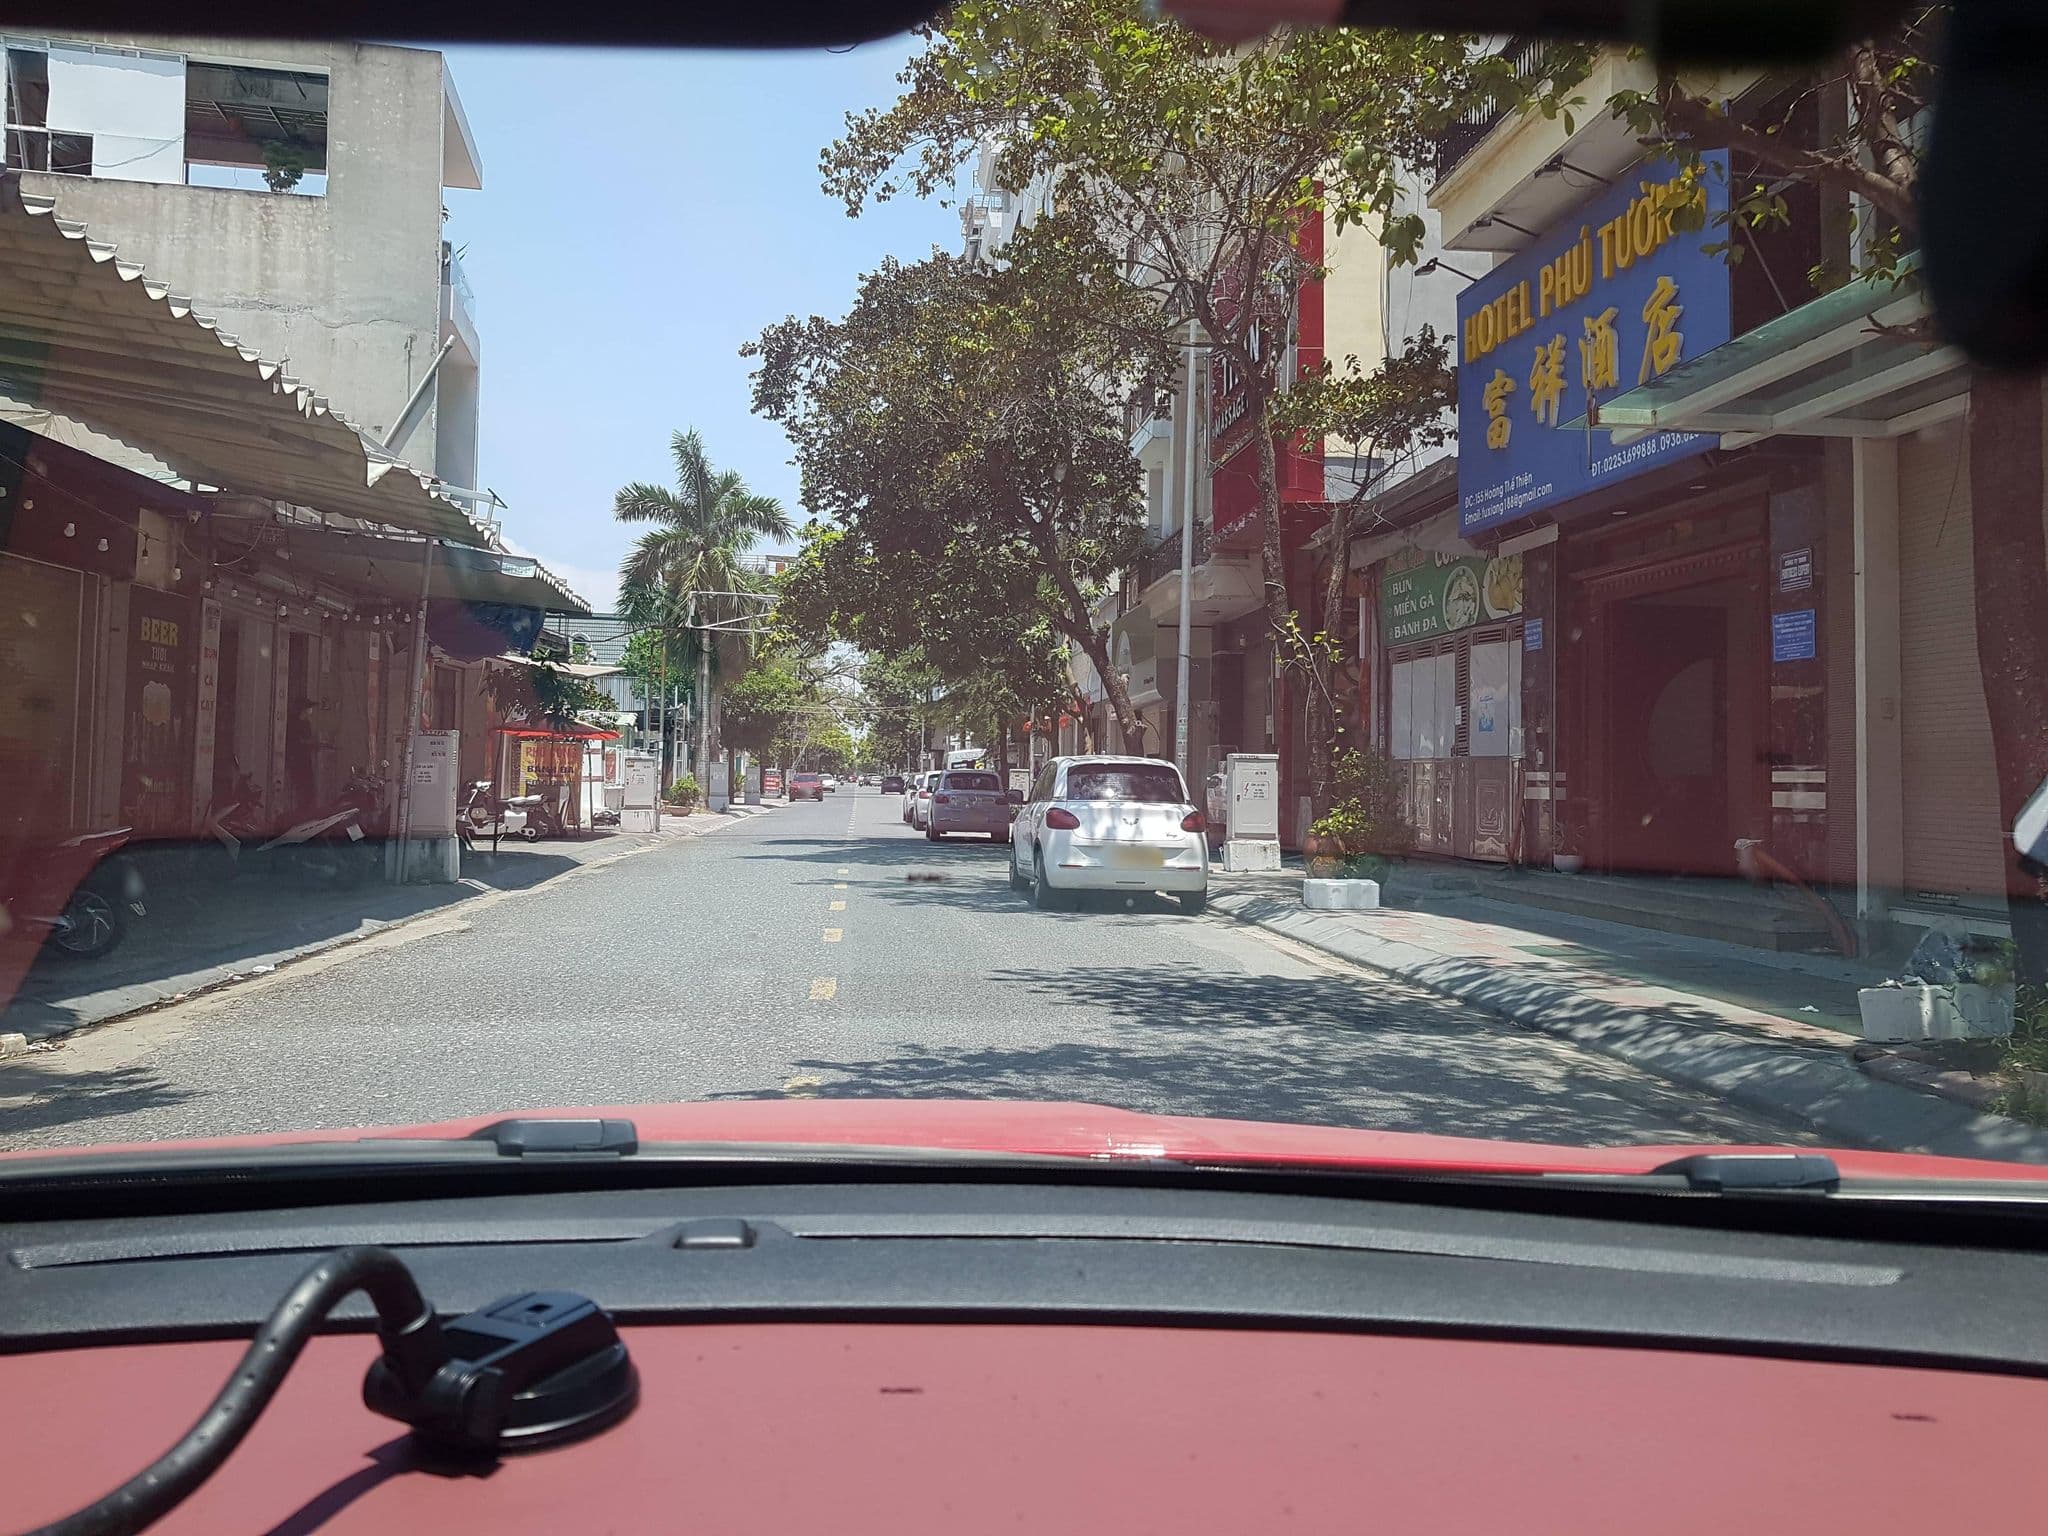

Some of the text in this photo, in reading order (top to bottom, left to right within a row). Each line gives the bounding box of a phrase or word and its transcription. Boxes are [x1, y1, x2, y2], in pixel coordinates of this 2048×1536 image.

[1464, 176, 1707, 364] HOTEL PHÚ TƯỜN
[1484, 484, 1504, 502] Hoàng
[1392, 576, 1413, 595] BÚN
[1419, 589, 1435, 610] GÀ
[141, 616, 178, 647] BEER
[1394, 615, 1438, 639] BÁNH ĐA
